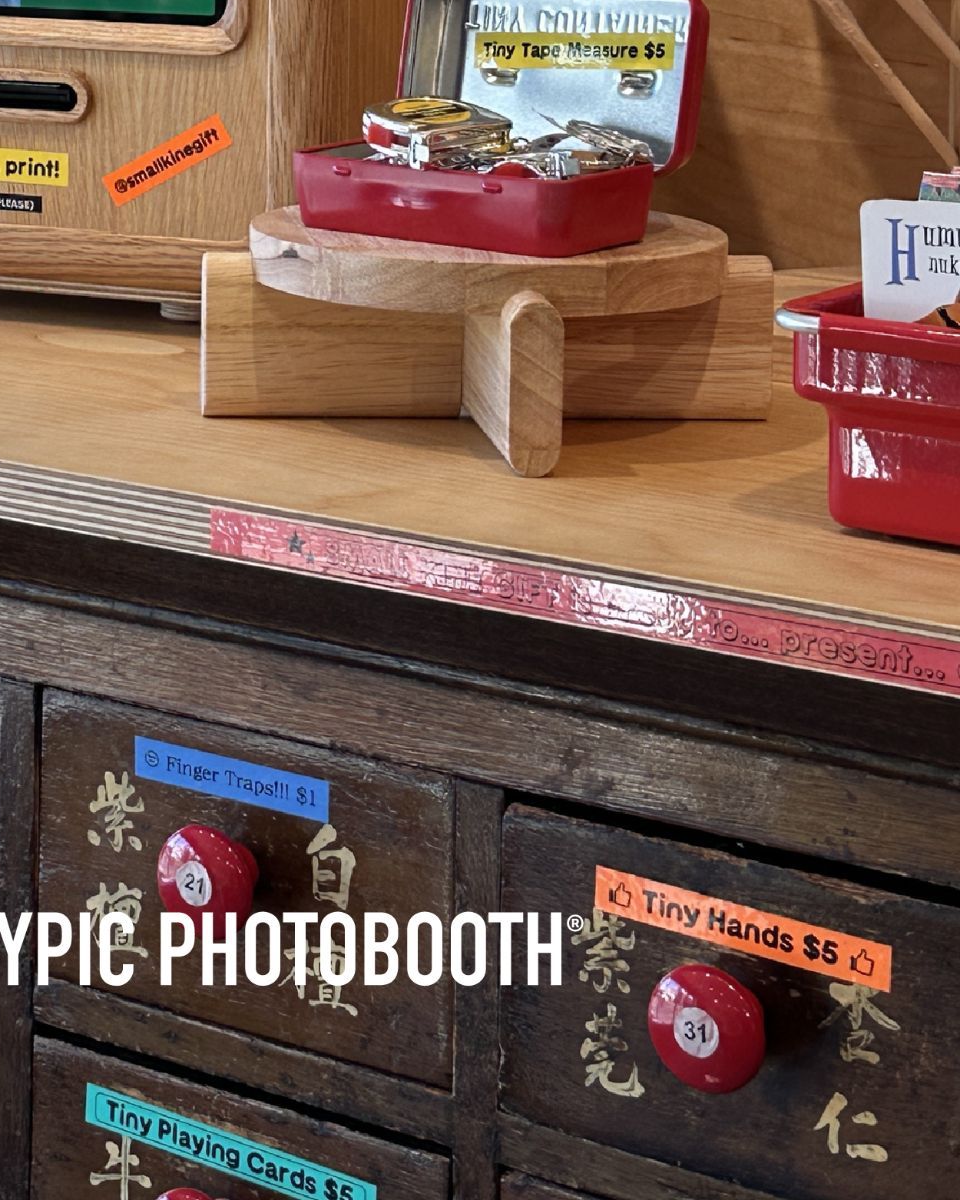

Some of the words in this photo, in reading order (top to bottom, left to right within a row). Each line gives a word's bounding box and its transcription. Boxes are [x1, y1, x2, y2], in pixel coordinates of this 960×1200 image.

[483, 41, 516, 59] Tiny
[521, 42, 562, 60] Tape
[568, 41, 638, 59] Measure
[644, 41, 666, 59] $5
[5, 156, 60, 179] print!
[114, 128, 220, 194] @smallkinegift
[780, 628, 945, 680] present...
[166, 756, 220, 783] Finger
[224, 769, 290, 801] Traps!!!
[295, 786, 317, 808] $1
[182, 873, 205, 895] 21
[641, 888, 700, 929] Tiny
[708, 906, 794, 953] Hands
[802, 932, 839, 965] $5
[683, 1020, 709, 1044] 31
[106, 1099, 153, 1137] Tiny
[158, 1119, 240, 1170] Playing
[247, 1152, 316, 1194] Cards
[323, 1178, 354, 1200] $5
